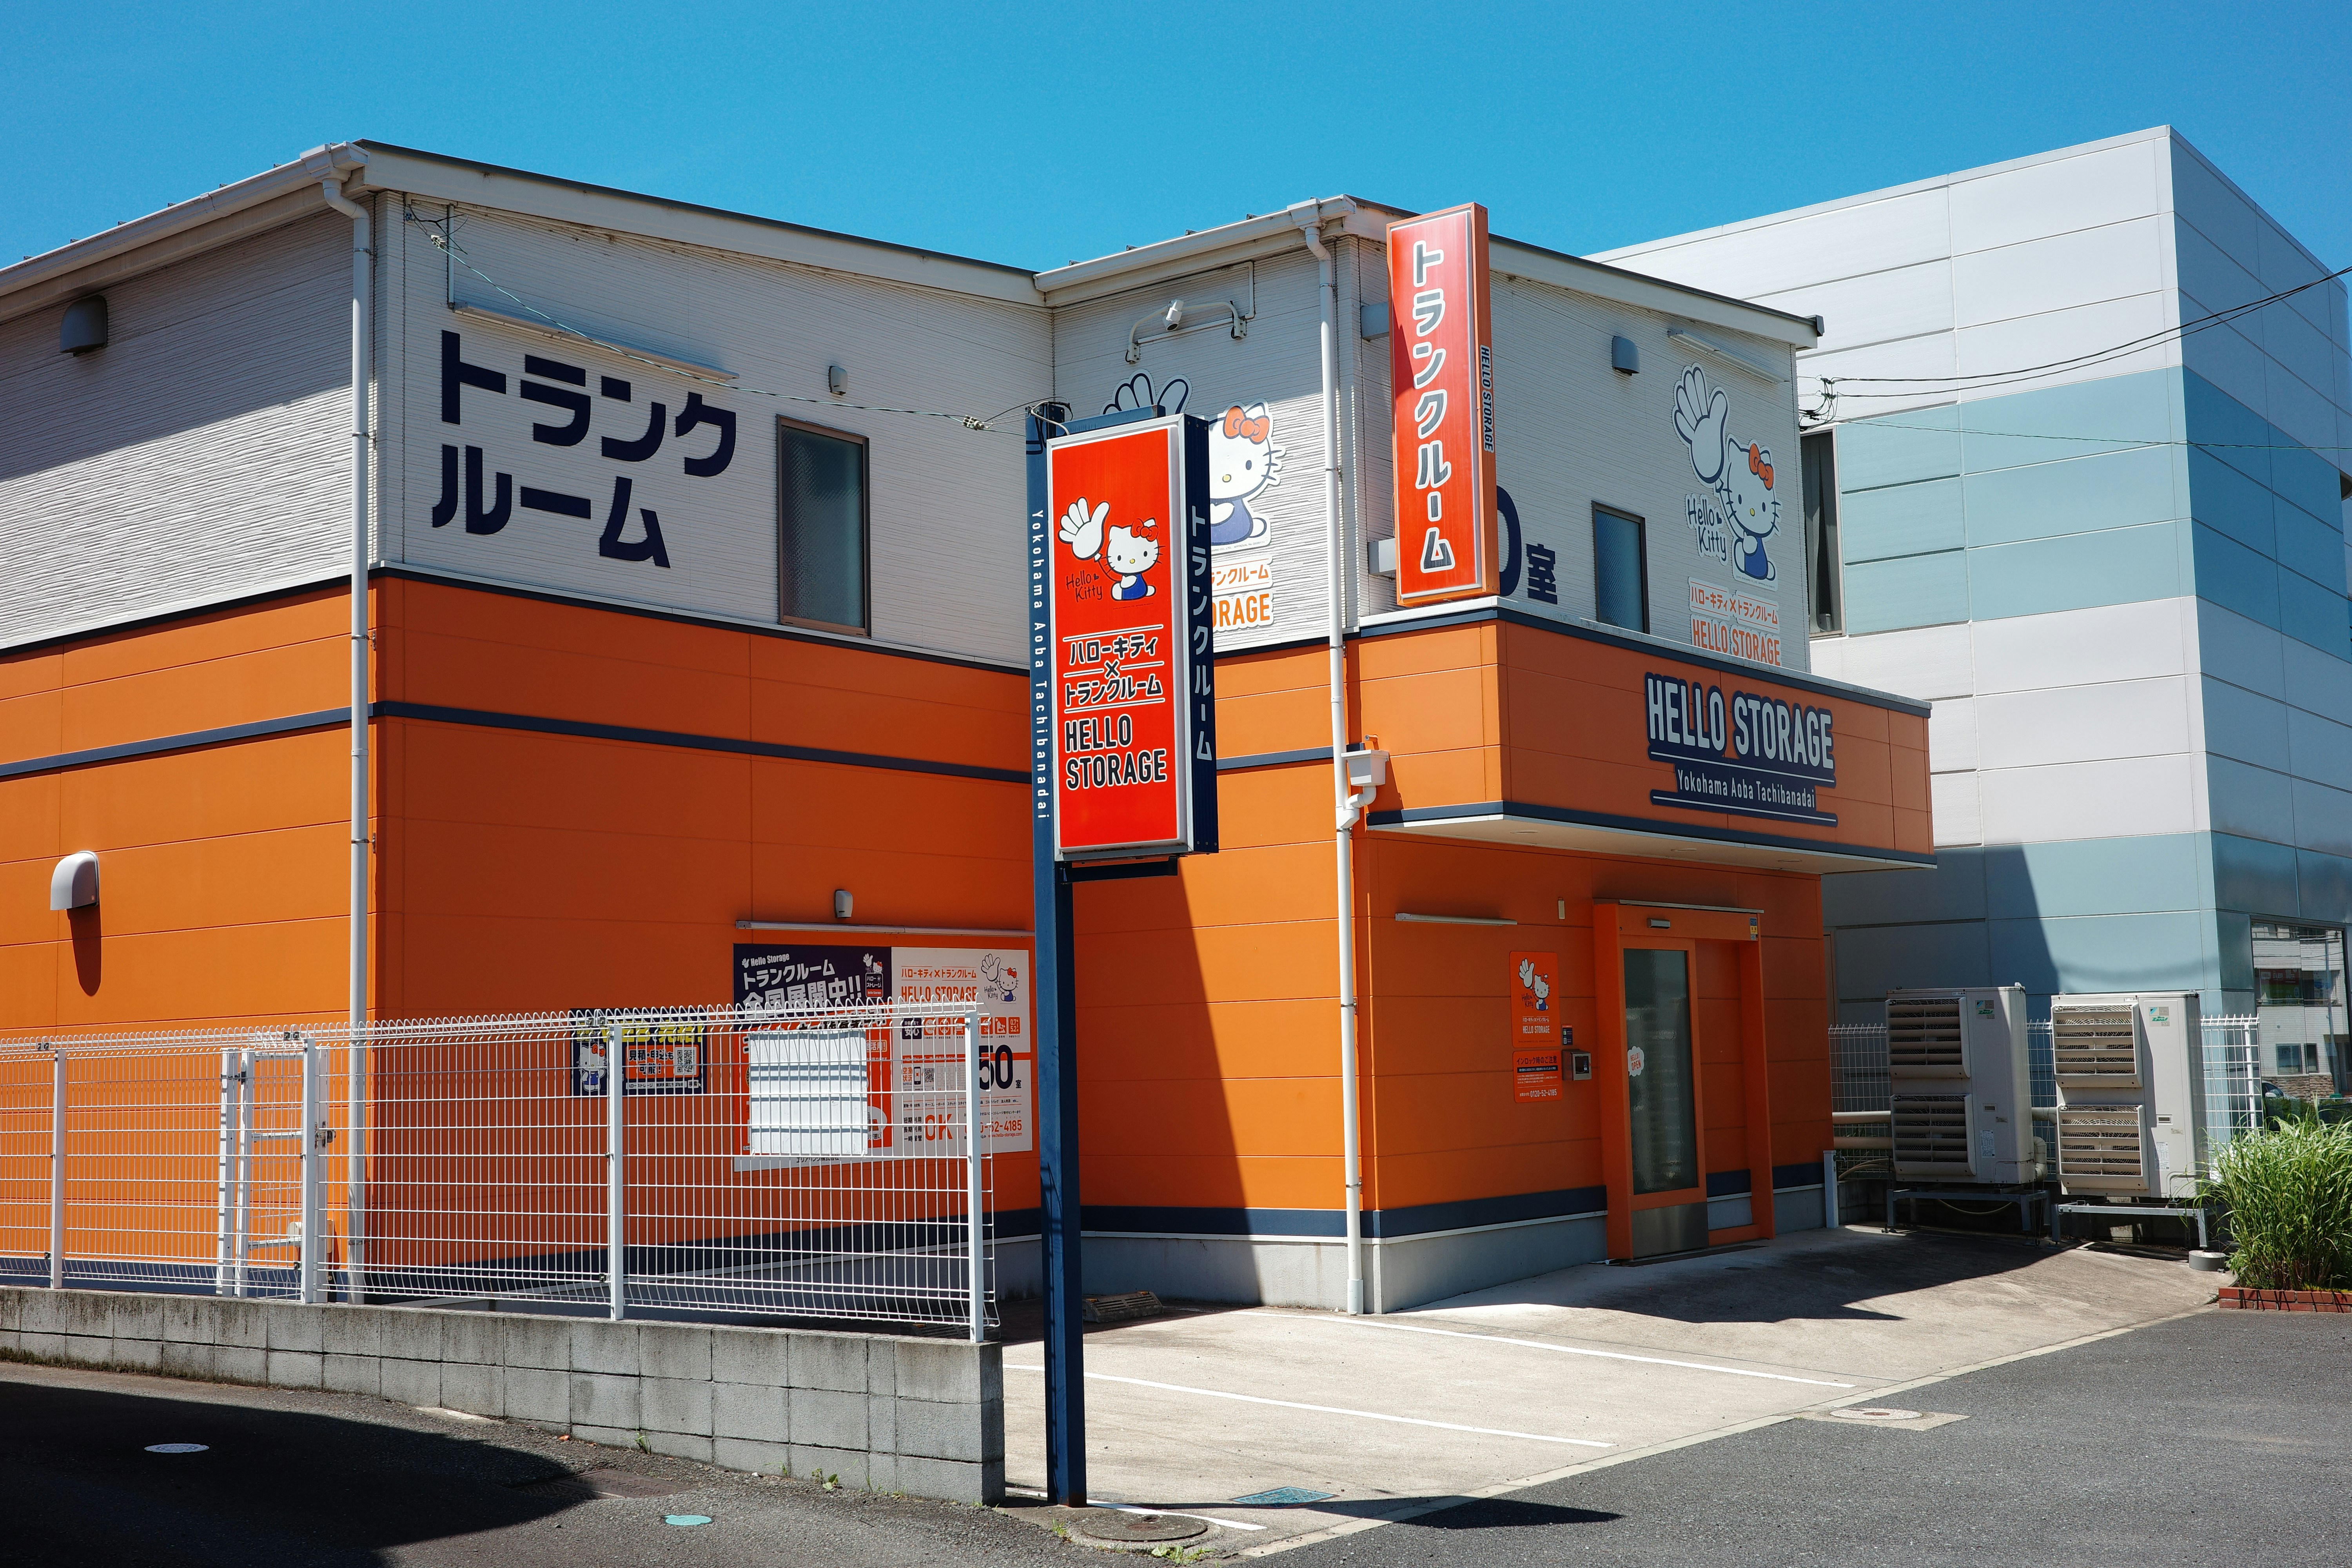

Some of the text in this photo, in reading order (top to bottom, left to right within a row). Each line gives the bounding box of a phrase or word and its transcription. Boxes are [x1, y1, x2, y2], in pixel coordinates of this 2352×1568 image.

[442, 330, 736, 477] トランク
[1413, 240, 1455, 573] トランクルーム
[1481, 347, 1494, 452] HELLO STORAGE
[432, 444, 670, 568] ルーム
[1688, 498, 1714, 526] Hello
[1699, 525, 1726, 561] Kitty
[1066, 570, 1091, 590] Hello
[1076, 584, 1103, 602] Kitty
[1069, 634, 1158, 666] ハローキティ
[1191, 506, 1212, 761] トランクルーム
[1693, 619, 1780, 666] HELLO STORAGE
[1031, 510, 1050, 818] Yokohama Aoba Tachibanadai
[1065, 675, 1163, 707] トランクルーム
[1065, 713, 1132, 752] HELLO
[1648, 678, 1834, 769] HELLO STORAGE
[1066, 749, 1167, 790] STORAGE
[1678, 769, 1815, 808] Yokohama Aoba Tachibanadai
[744, 959, 835, 990] トランクルーム
[750, 953, 790, 967] Hello Storage
[901, 986, 977, 1002] HELLO STORAGE
[1630, 1052, 1640, 1061] HELLO!
[1631, 1059, 1641, 1071] OPEN
[1530, 1089, 1557, 1098] 0120-52-4185
[925, 1114, 953, 1141] OK
